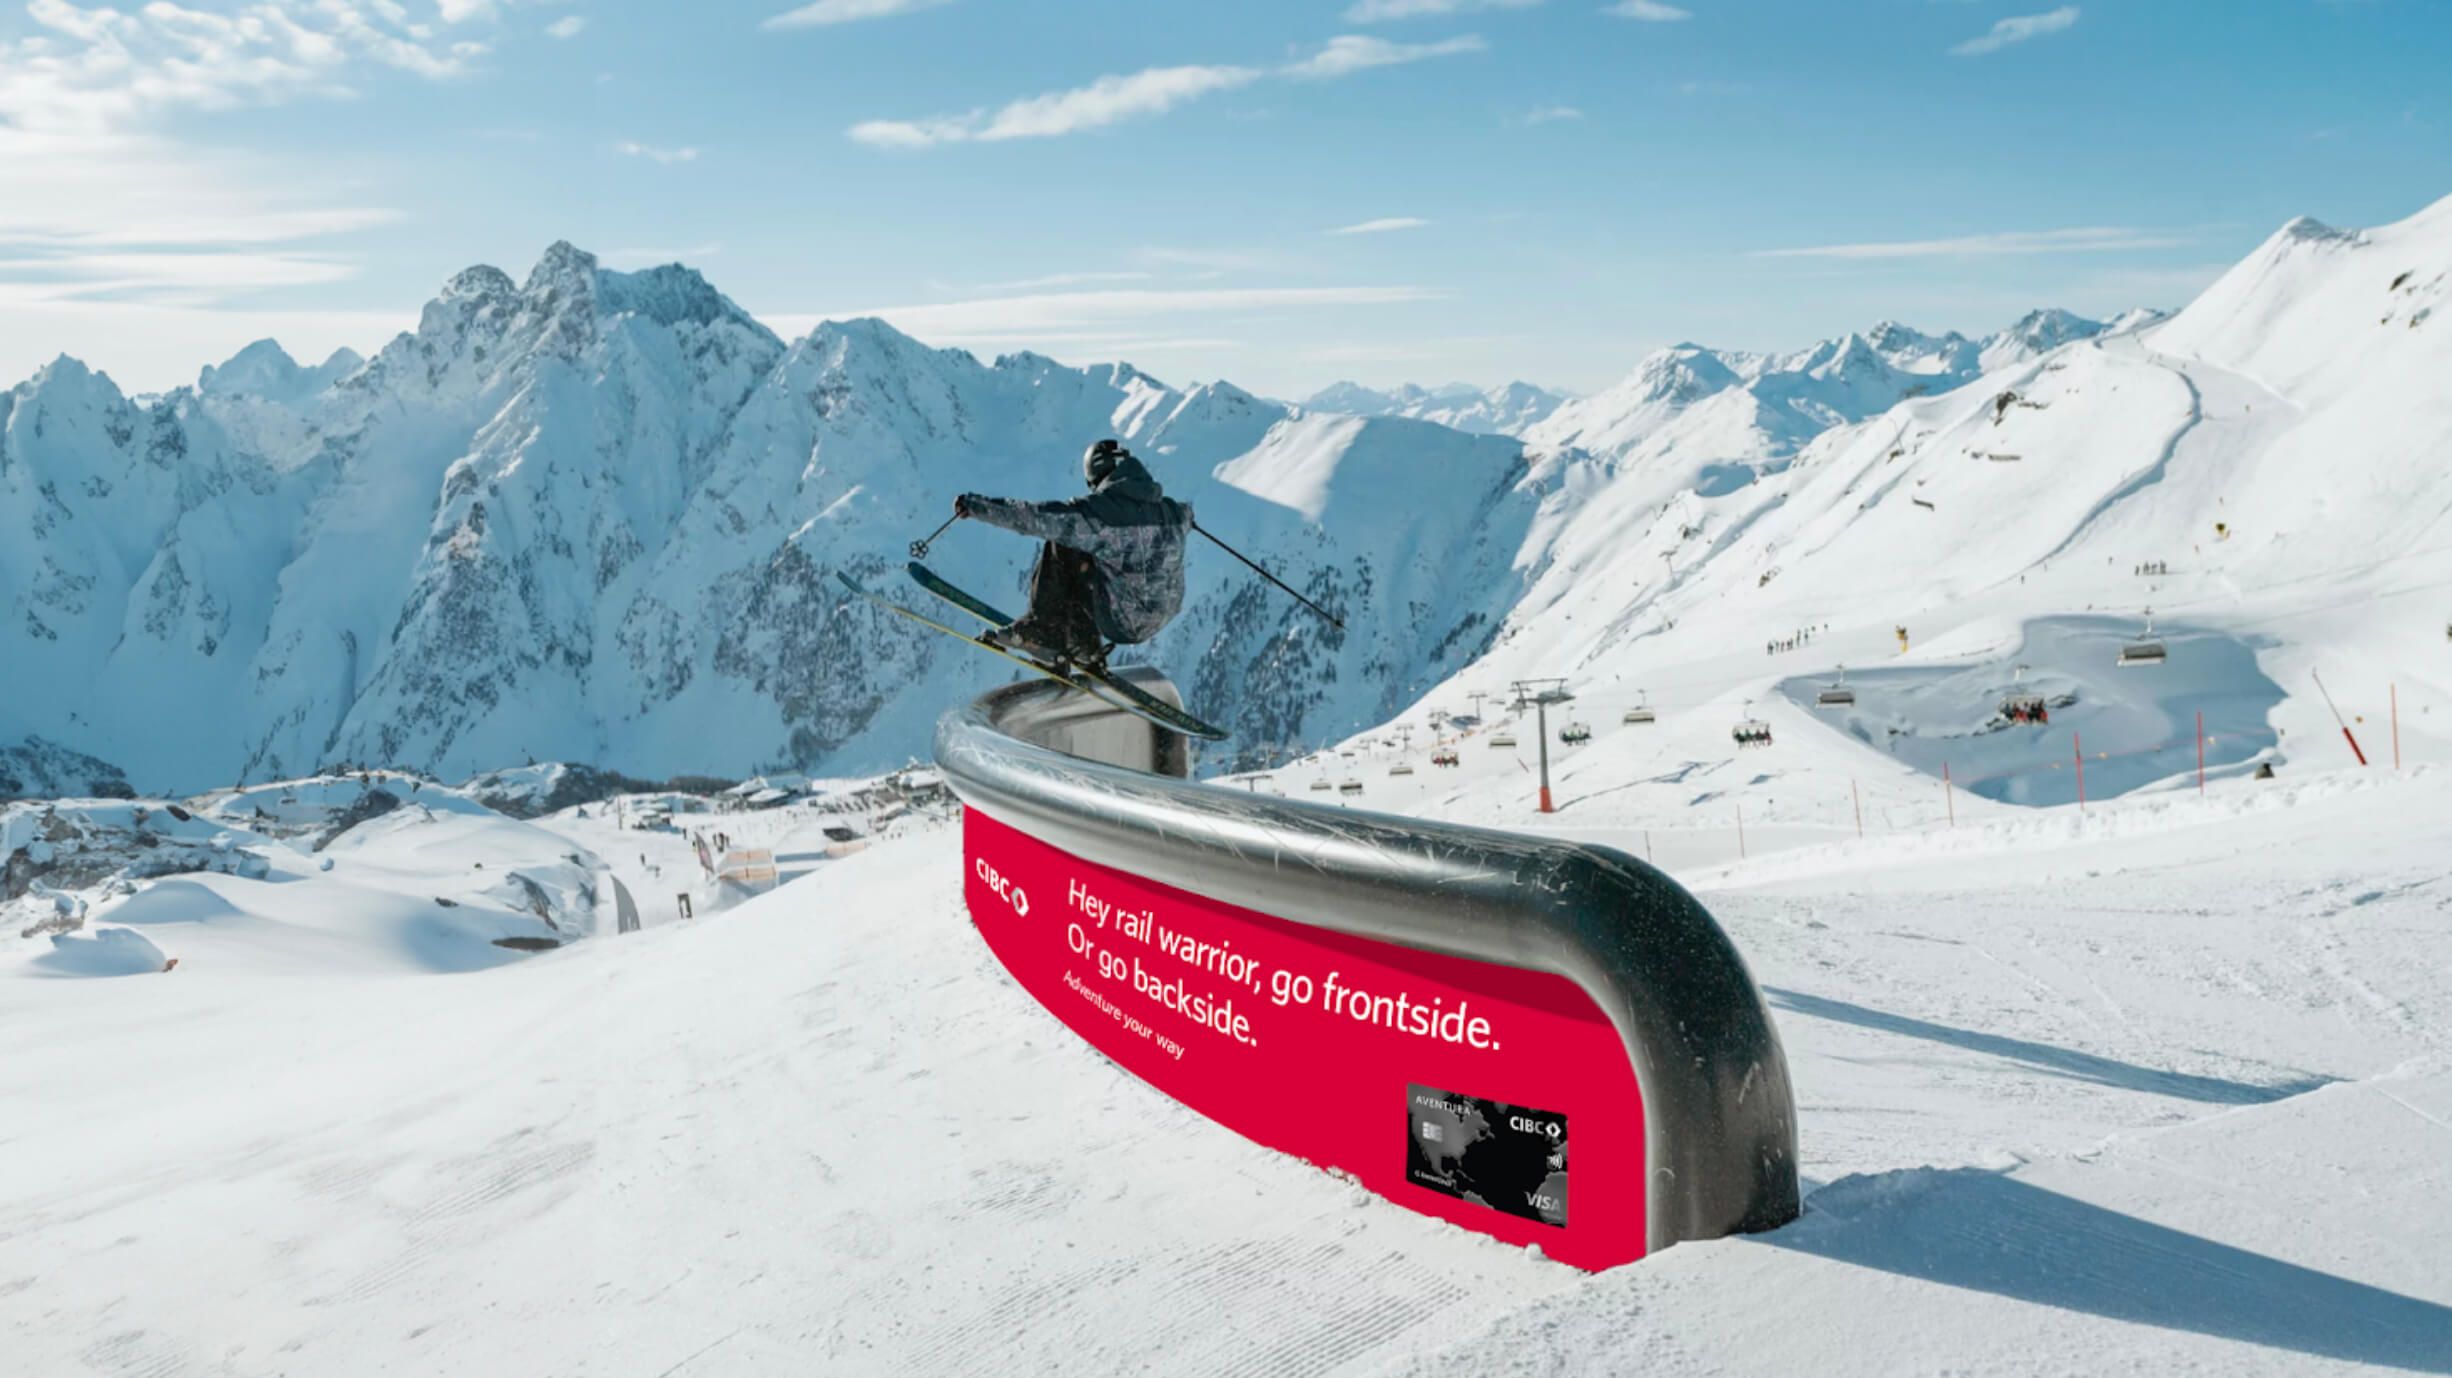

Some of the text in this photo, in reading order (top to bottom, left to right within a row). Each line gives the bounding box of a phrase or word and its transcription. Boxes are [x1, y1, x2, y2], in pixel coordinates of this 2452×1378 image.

[975, 857, 1010, 903] CIBC
[1067, 922, 1257, 1047] Or go backside.
[1068, 877, 1500, 1051] Hey rail warrior, go frontside.
[1063, 969, 1185, 1061] Adventure your way
[1415, 1095, 1472, 1116] AVENTURA
[1509, 1116, 1545, 1135] CIBC
[1523, 1191, 1561, 1212] VISA
